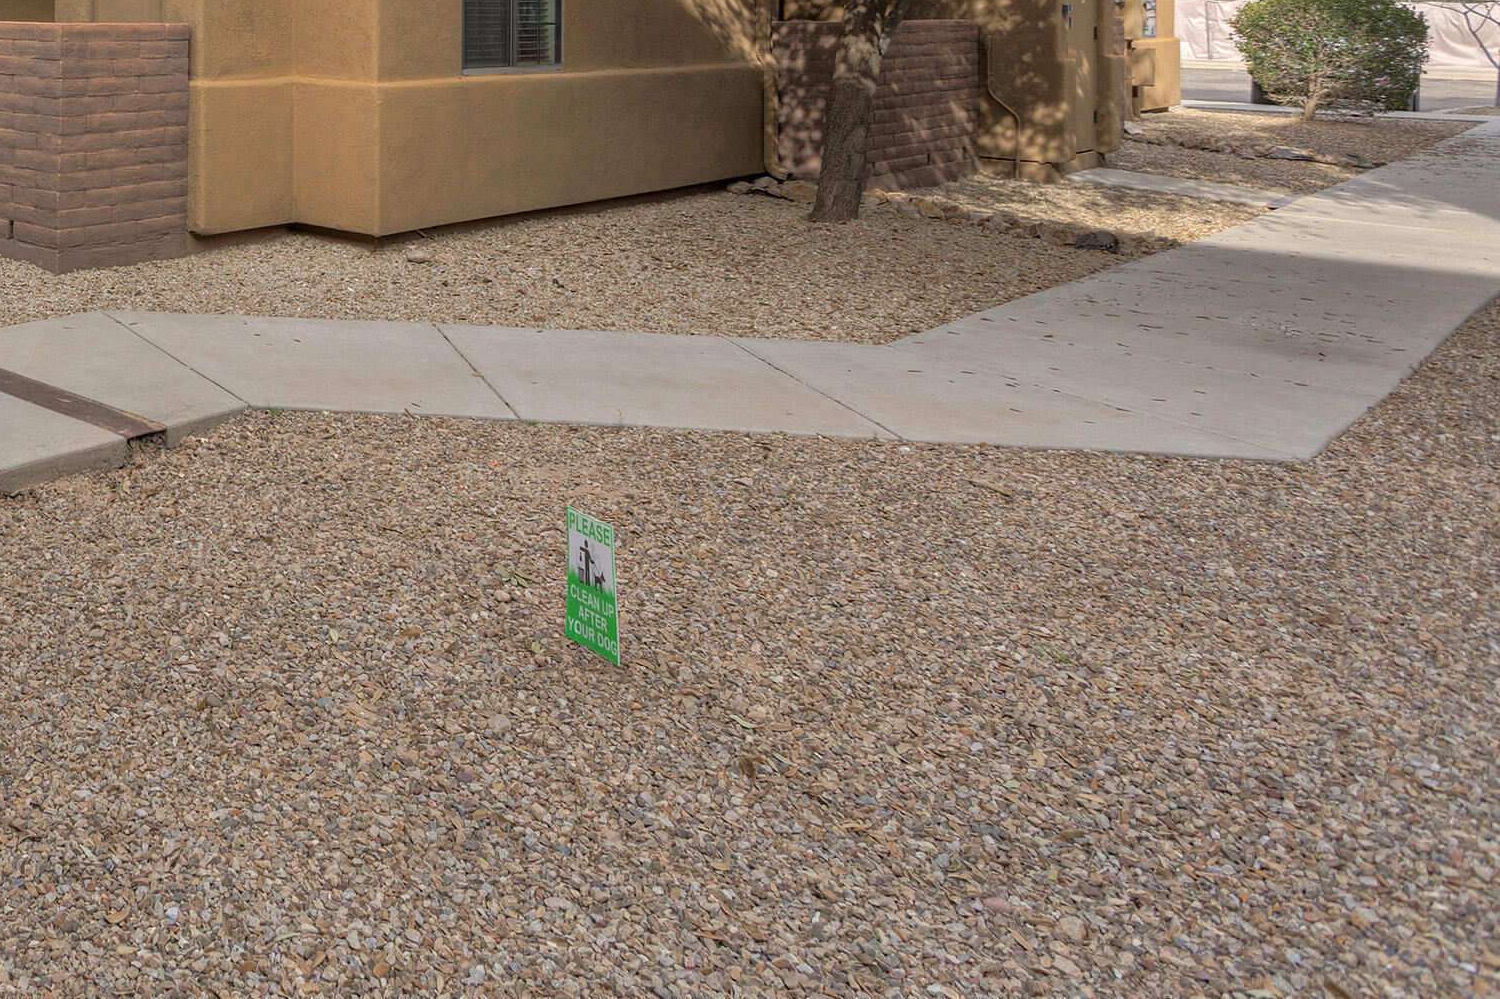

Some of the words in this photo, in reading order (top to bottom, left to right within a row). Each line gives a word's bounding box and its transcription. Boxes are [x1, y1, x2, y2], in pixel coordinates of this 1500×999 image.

[569, 512, 611, 548] PLEASE
[570, 584, 600, 611] CLEAN
[601, 601, 615, 619] UP
[567, 616, 596, 643] YOUR
[597, 632, 618, 657] DOG
[578, 605, 608, 634] AFTER
